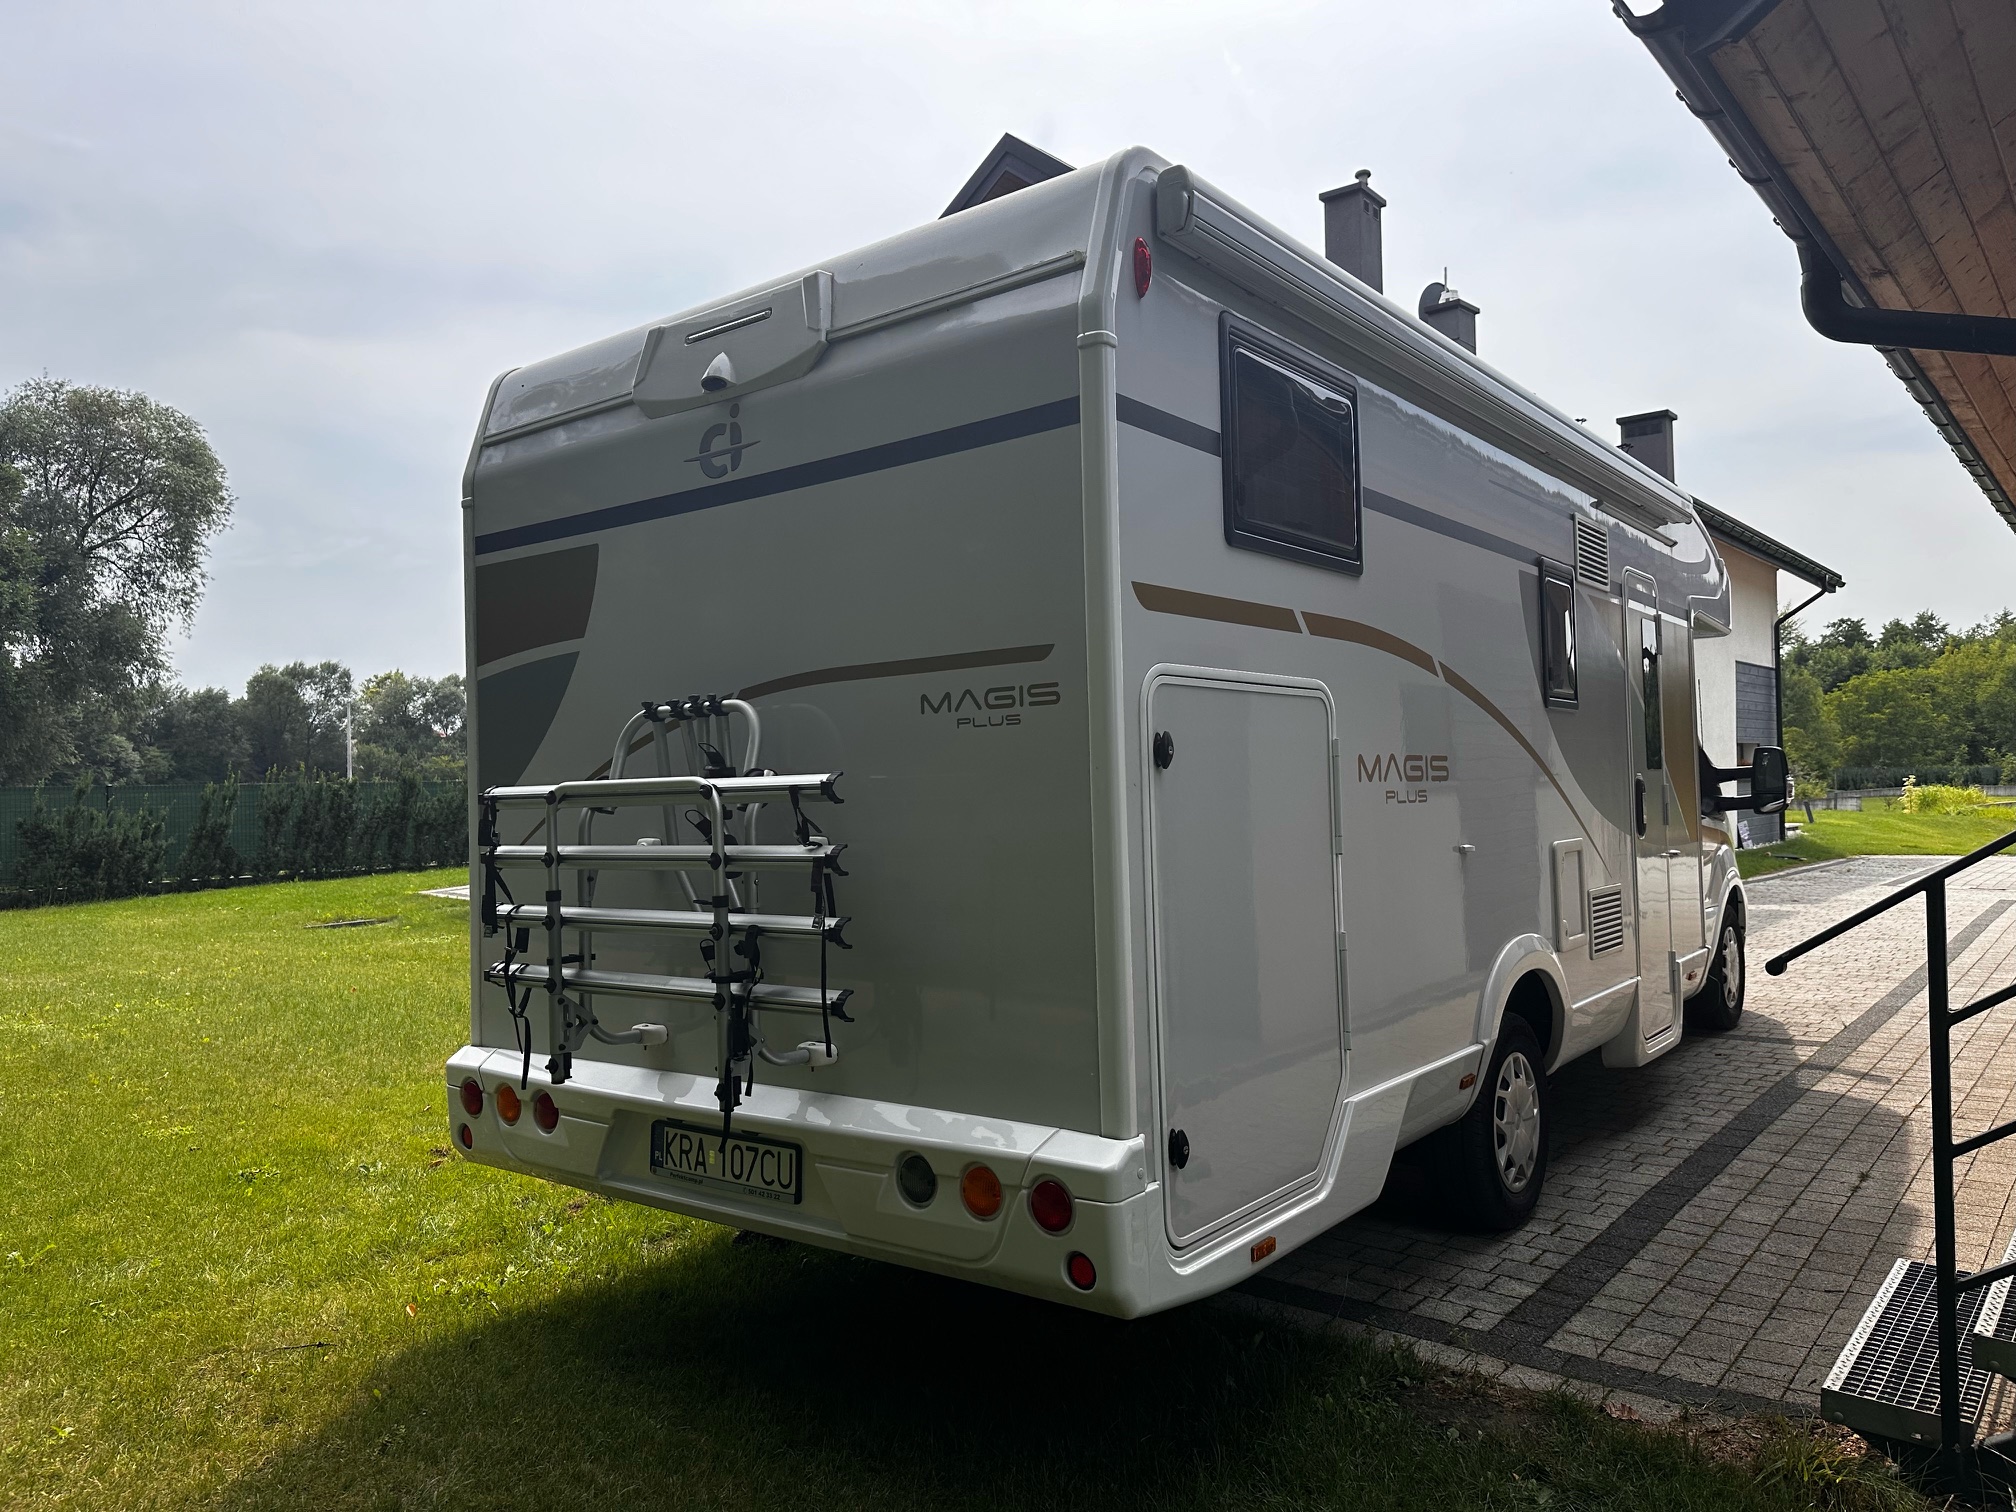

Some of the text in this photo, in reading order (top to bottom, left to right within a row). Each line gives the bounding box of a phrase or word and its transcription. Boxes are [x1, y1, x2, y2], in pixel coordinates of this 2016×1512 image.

[920, 681, 1061, 715] MAGIS
[956, 713, 1022, 729] PLUS
[1357, 753, 1450, 783] MAGIS
[1385, 789, 1428, 804] PLUS
[654, 1150, 663, 1161] PL
[665, 1131, 793, 1189] KRA 107CU
[748, 1188, 757, 1196] 501
[758, 1190, 765, 1198] 42
